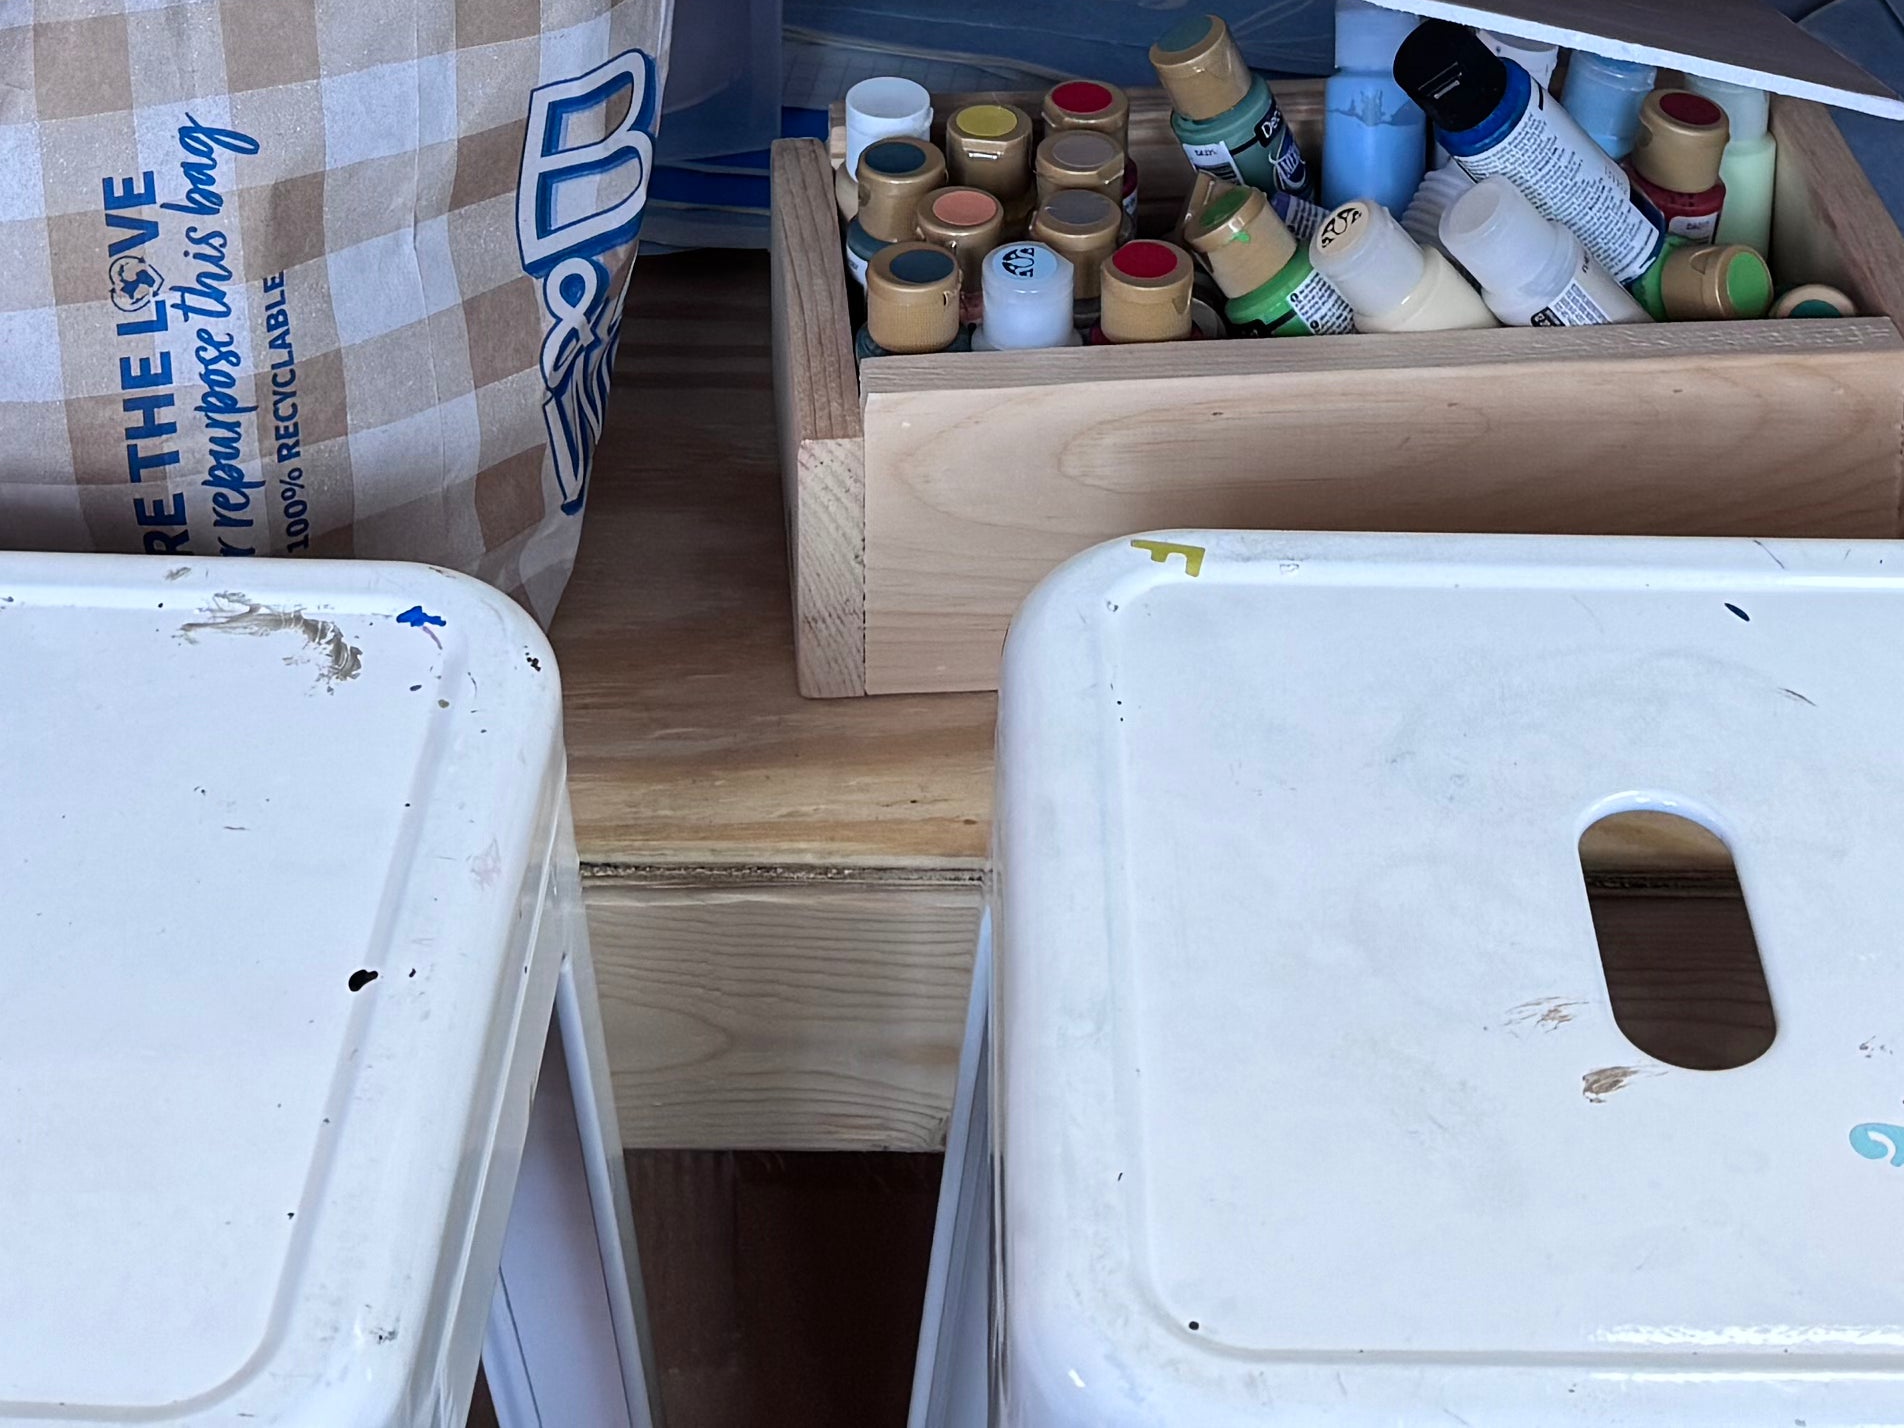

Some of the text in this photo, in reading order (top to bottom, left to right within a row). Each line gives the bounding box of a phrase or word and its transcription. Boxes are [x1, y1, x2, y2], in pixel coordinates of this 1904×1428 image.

[160, 111, 260, 217] bag
[101, 169, 169, 336] LOVE
[169, 227, 233, 323] this
[119, 351, 180, 483] THE
[193, 327, 265, 528] repurpose
[263, 270, 310, 552] 100% RECYCLABLE
